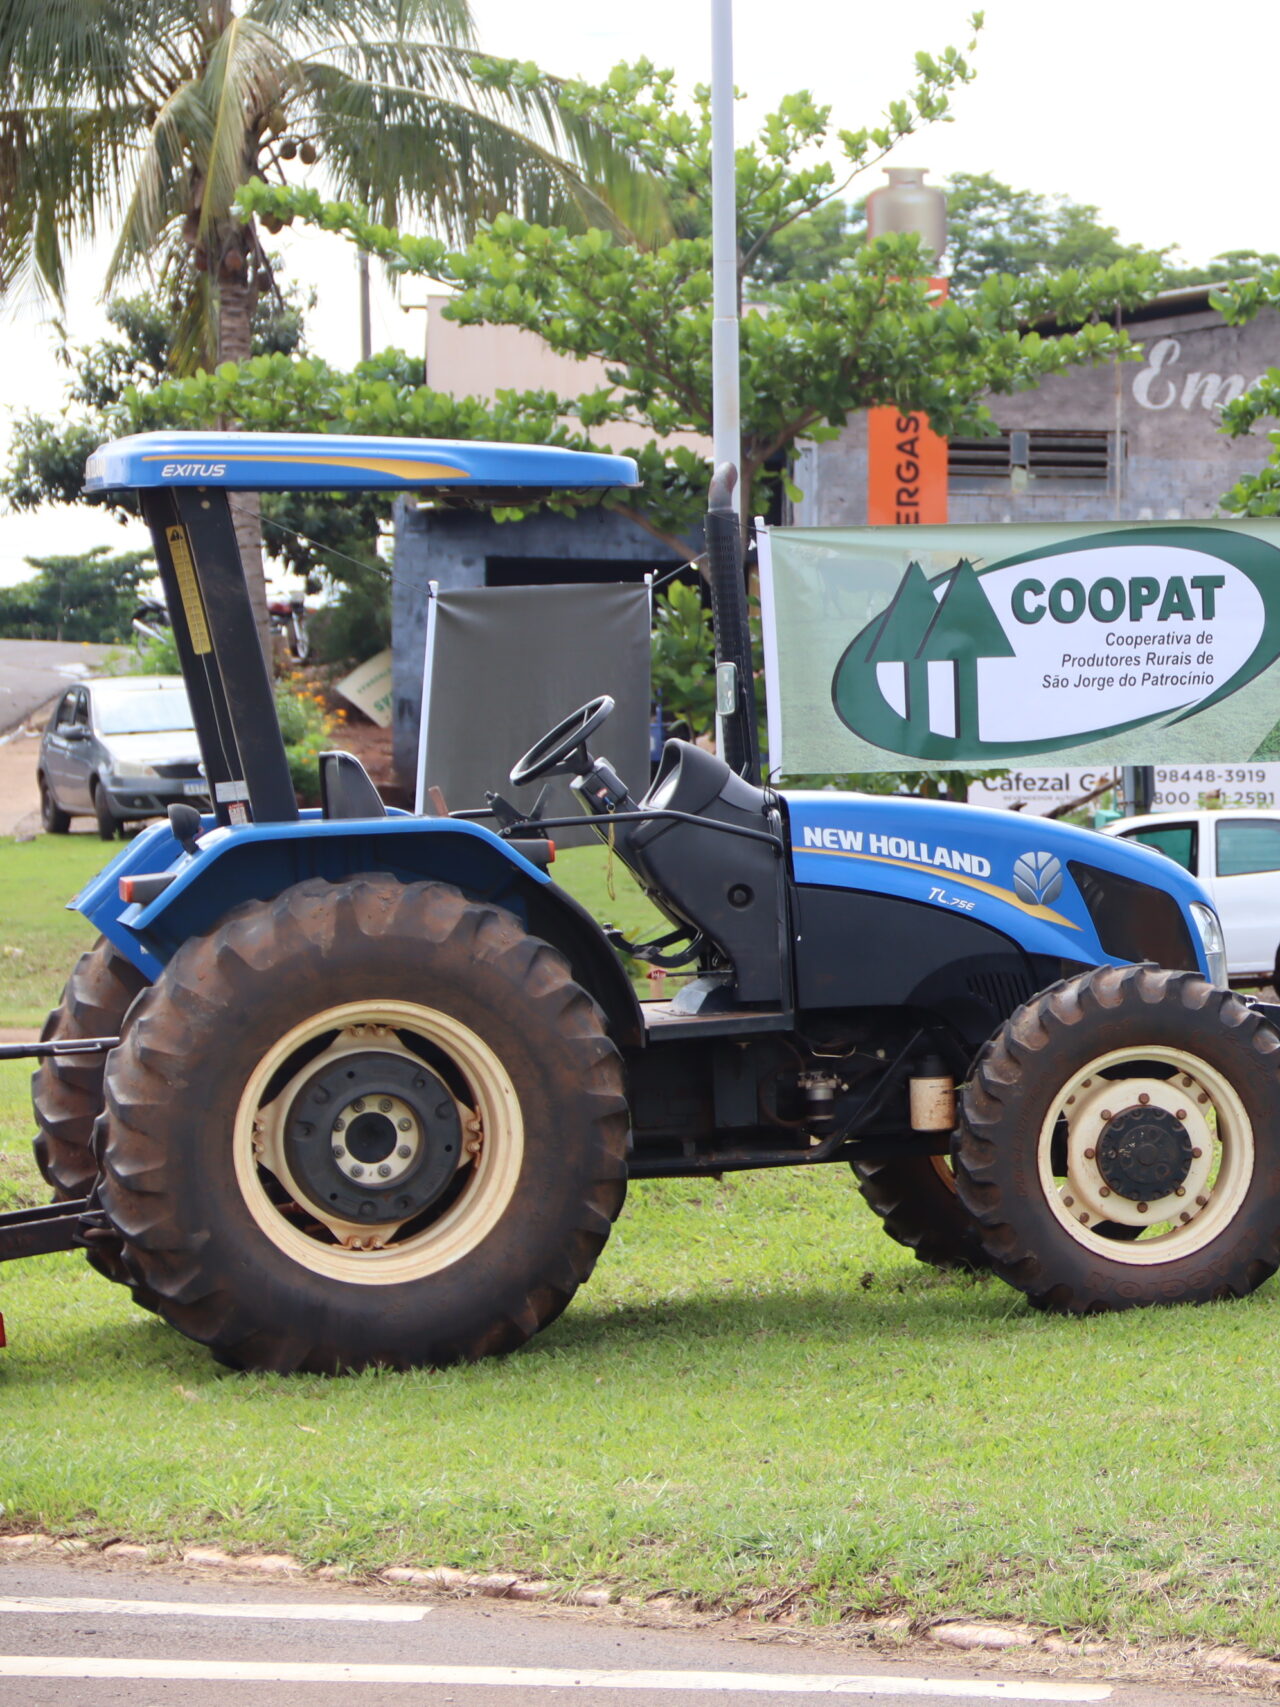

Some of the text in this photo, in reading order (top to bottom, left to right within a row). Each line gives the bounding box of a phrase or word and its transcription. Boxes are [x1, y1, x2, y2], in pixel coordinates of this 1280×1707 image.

[1132, 339, 1268, 411] Em
[161, 463, 227, 477] EXITUS
[1011, 574, 1226, 625] COOPAT
[1105, 631, 1213, 649] Cooperativa de
[1061, 651, 1214, 668] Produtores Rurais de
[1042, 671, 1214, 691] São Jorge do Patrocínio
[982, 772, 1070, 792] Cafezal
[1156, 769, 1266, 783] 98448-3919
[1198, 791, 1226, 805] 51
[803, 826, 991, 879] NEW HOLLAND
